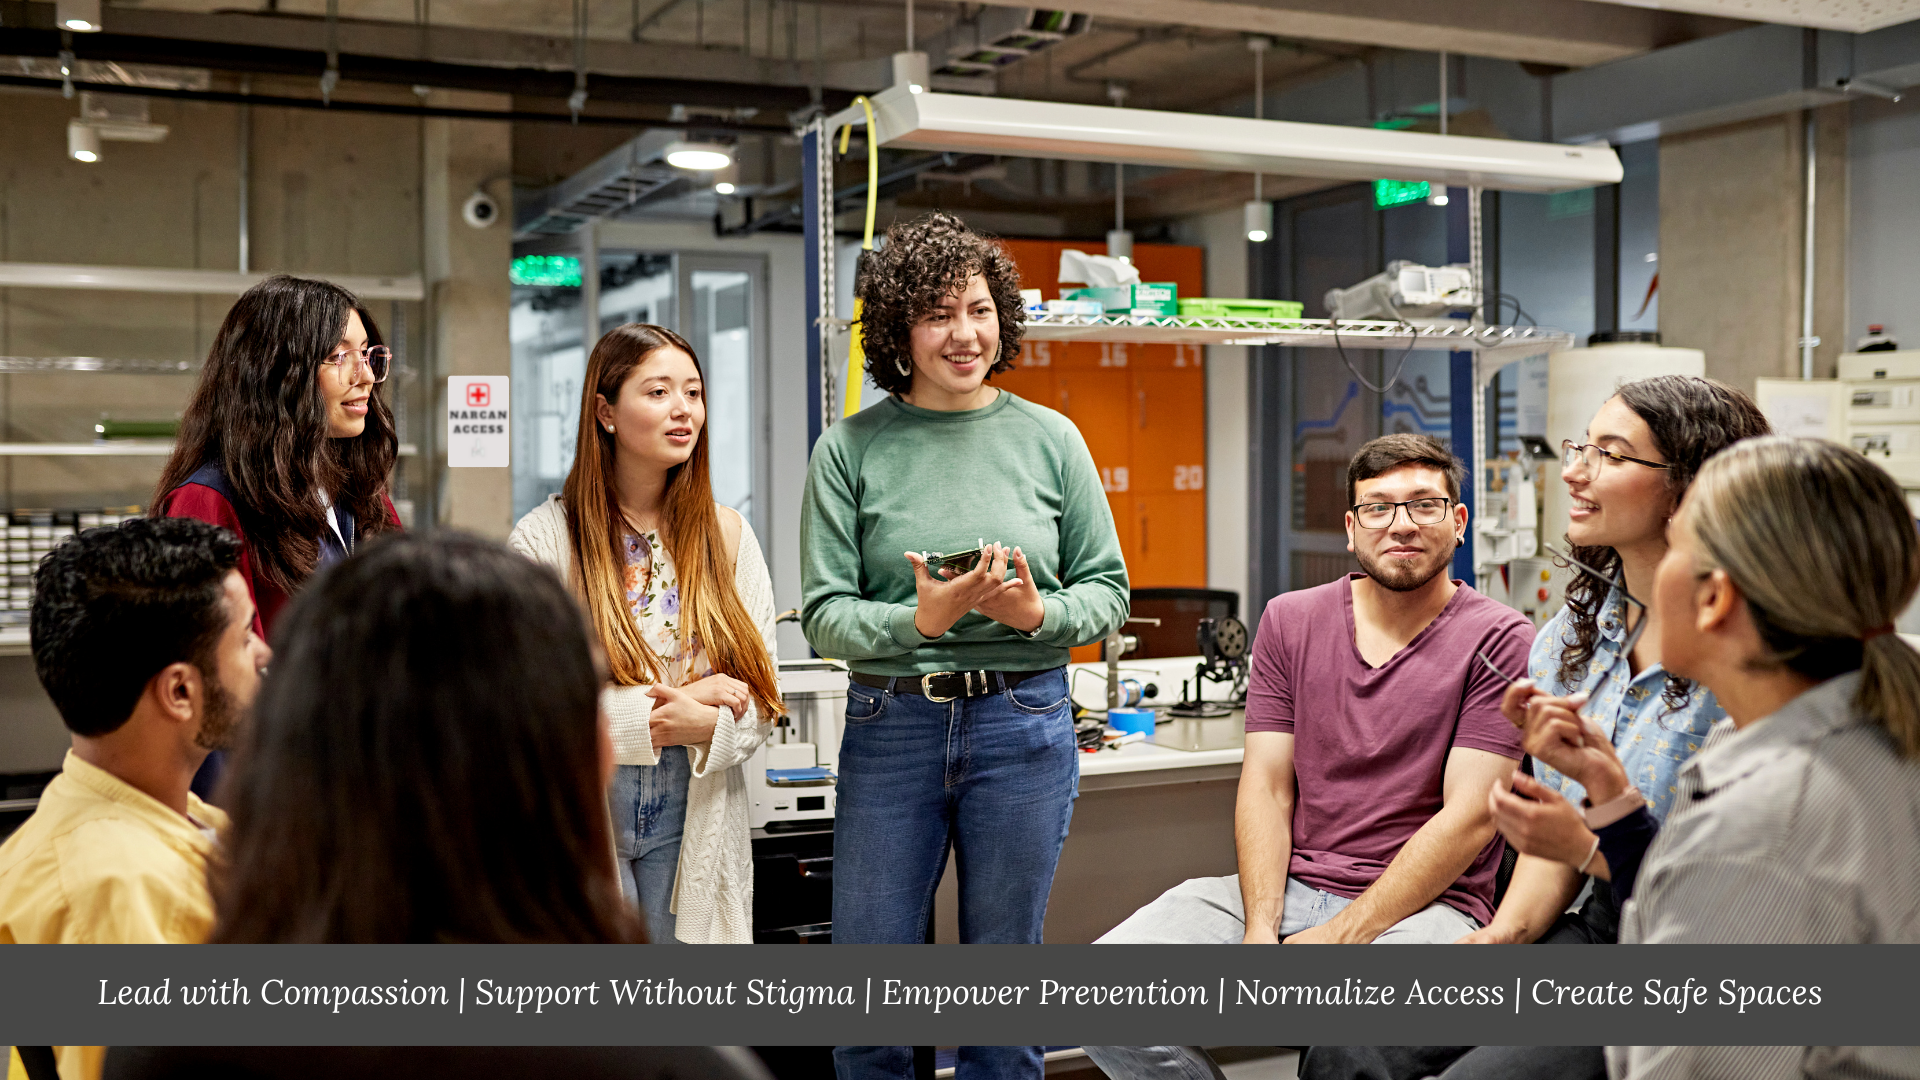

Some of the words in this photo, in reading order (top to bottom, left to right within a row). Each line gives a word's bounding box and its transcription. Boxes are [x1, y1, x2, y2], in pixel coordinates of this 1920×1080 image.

[1023, 342, 1051, 366] 15
[1100, 342, 1127, 367] 16
[1174, 343, 1201, 367] 17
[449, 410, 508, 420] NARCAN
[453, 424, 504, 434] ACCESS
[1102, 467, 1129, 492] 19
[1174, 465, 1203, 490] 20
